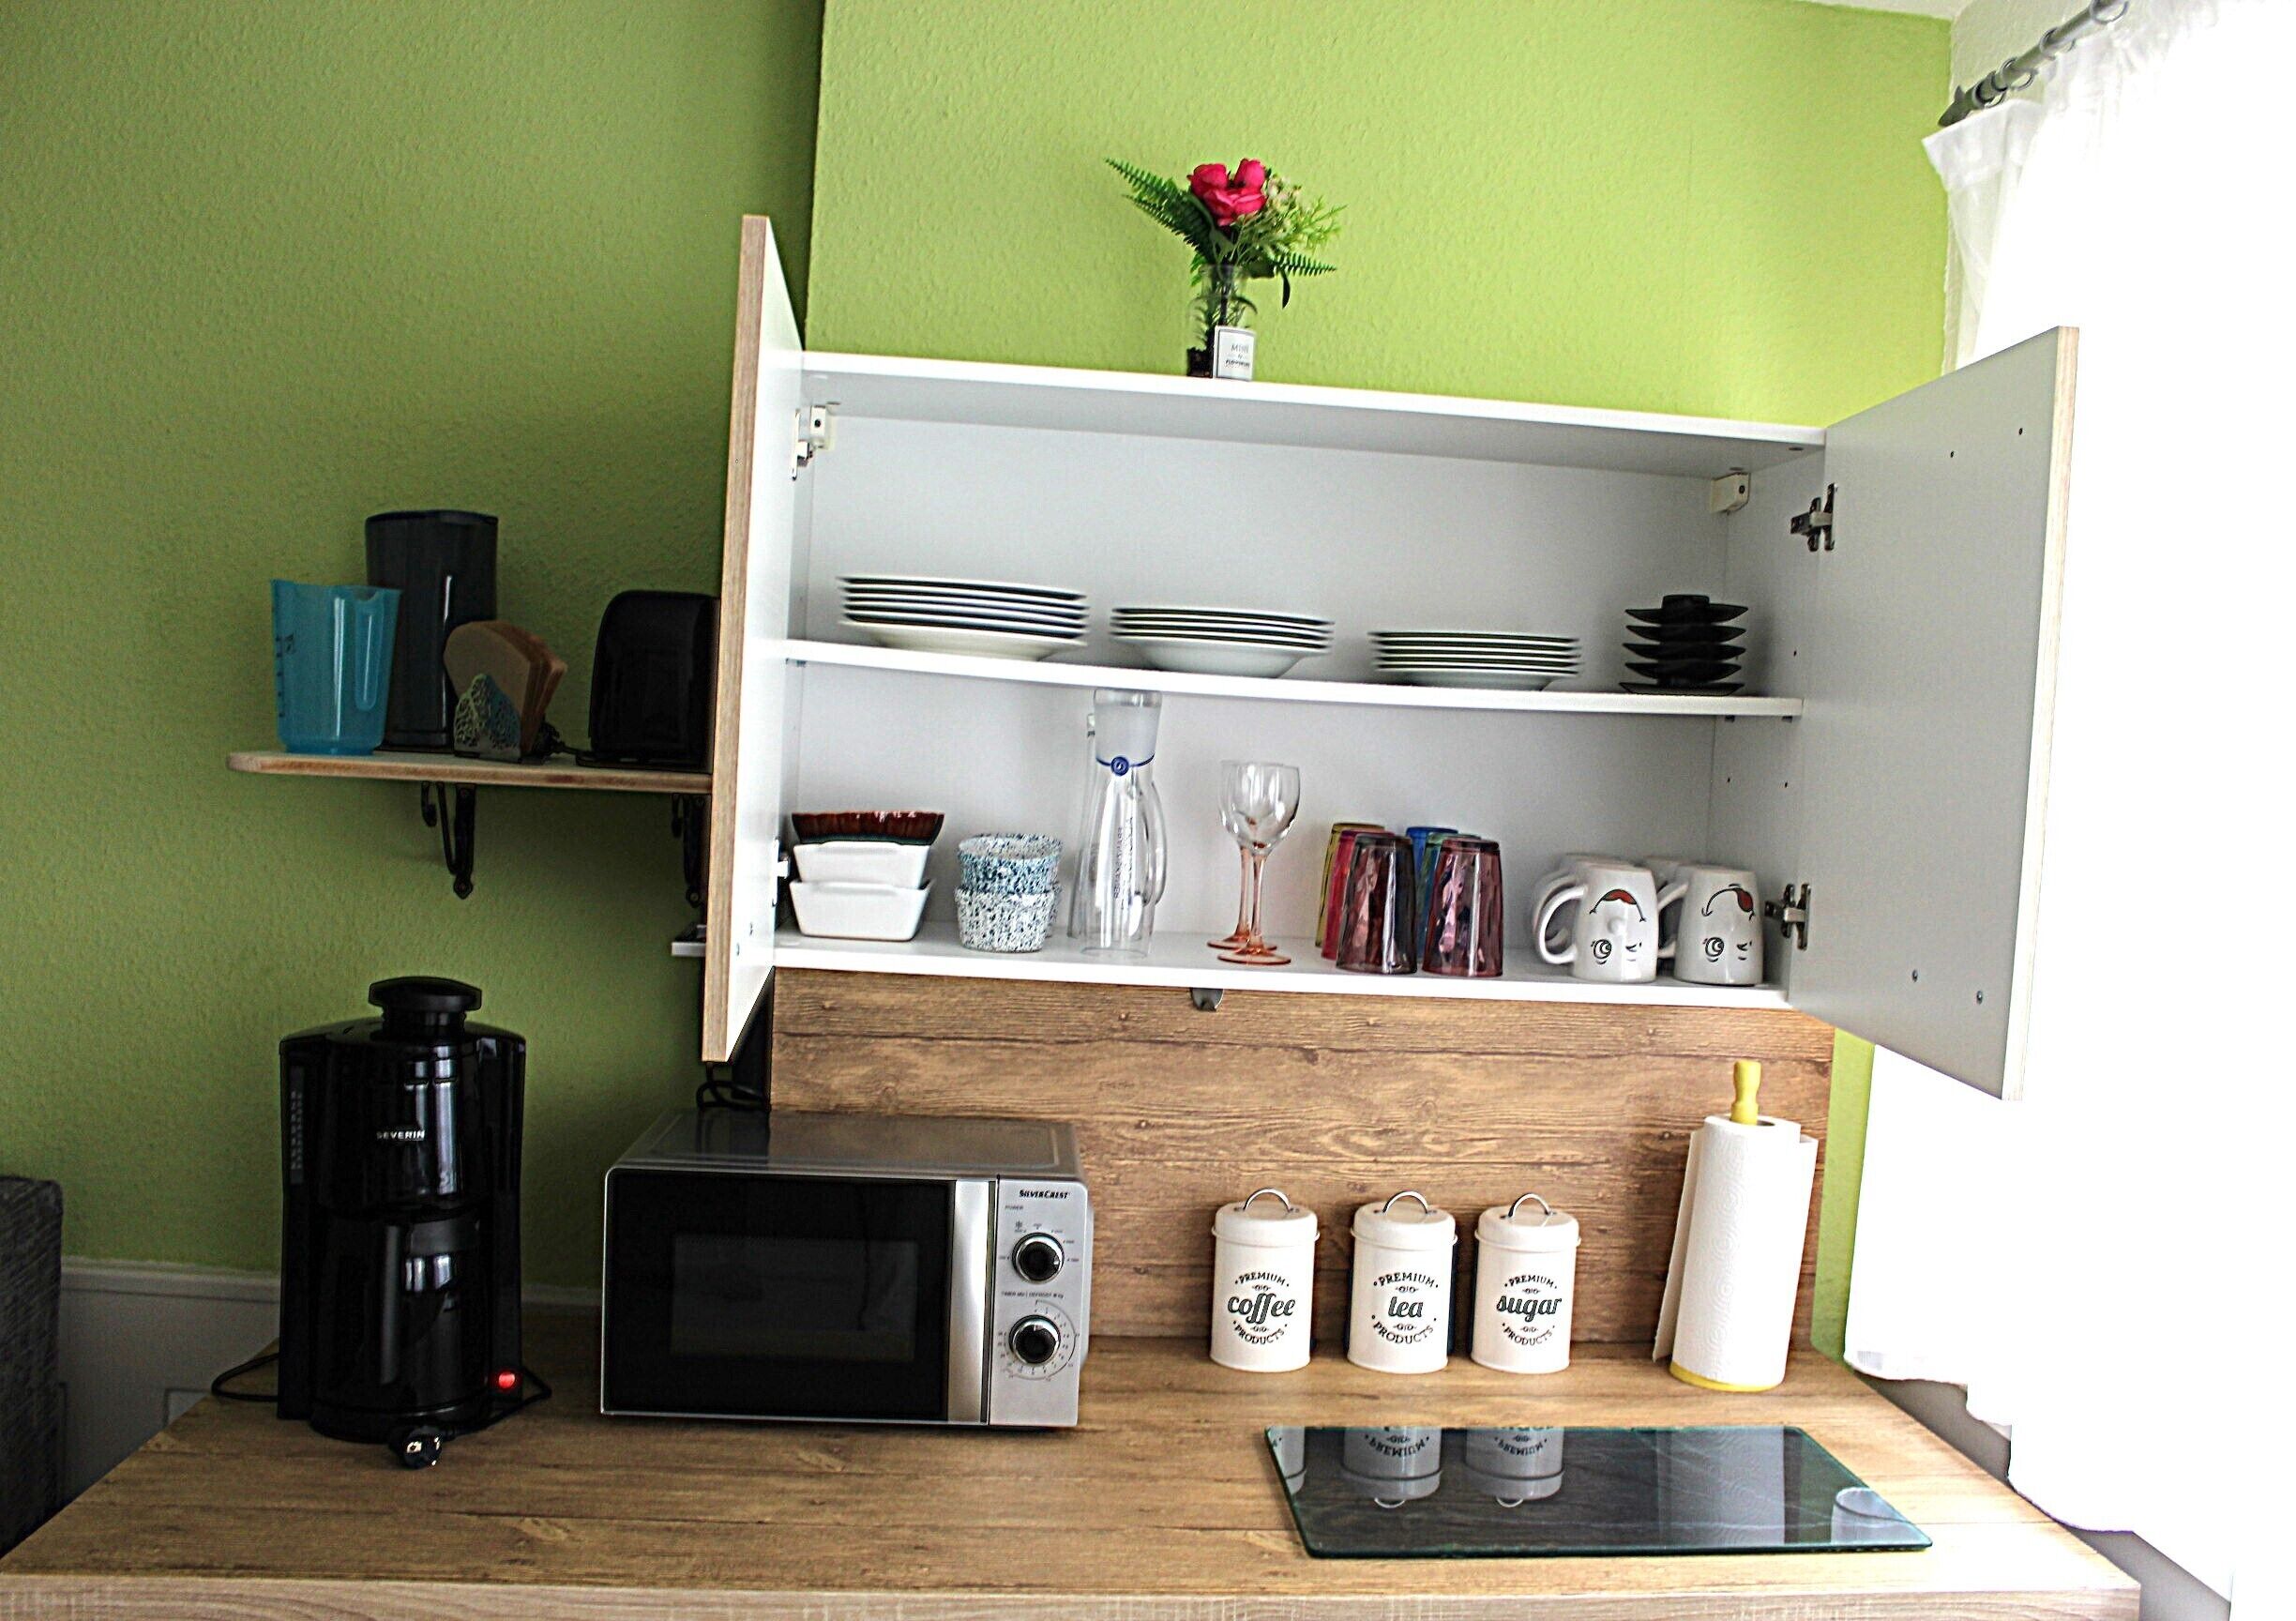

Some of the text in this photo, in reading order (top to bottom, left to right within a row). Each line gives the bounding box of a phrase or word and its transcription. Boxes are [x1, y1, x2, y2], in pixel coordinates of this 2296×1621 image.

[376, 1130, 425, 1140] SEVERIN
[1239, 1272, 1285, 1285] PREMIUM
[1379, 1272, 1434, 1288] PREMIUM
[1508, 1275, 1554, 1288] PREMIUM
[1227, 1293, 1296, 1325] coffee
[1388, 1296, 1424, 1318] tea
[1496, 1295, 1563, 1323] sugar
[1234, 1324, 1284, 1345] PRODUCTS
[1373, 1321, 1434, 1344] PRODUCTS
[1503, 1326, 1552, 1346] PRODUCTS
